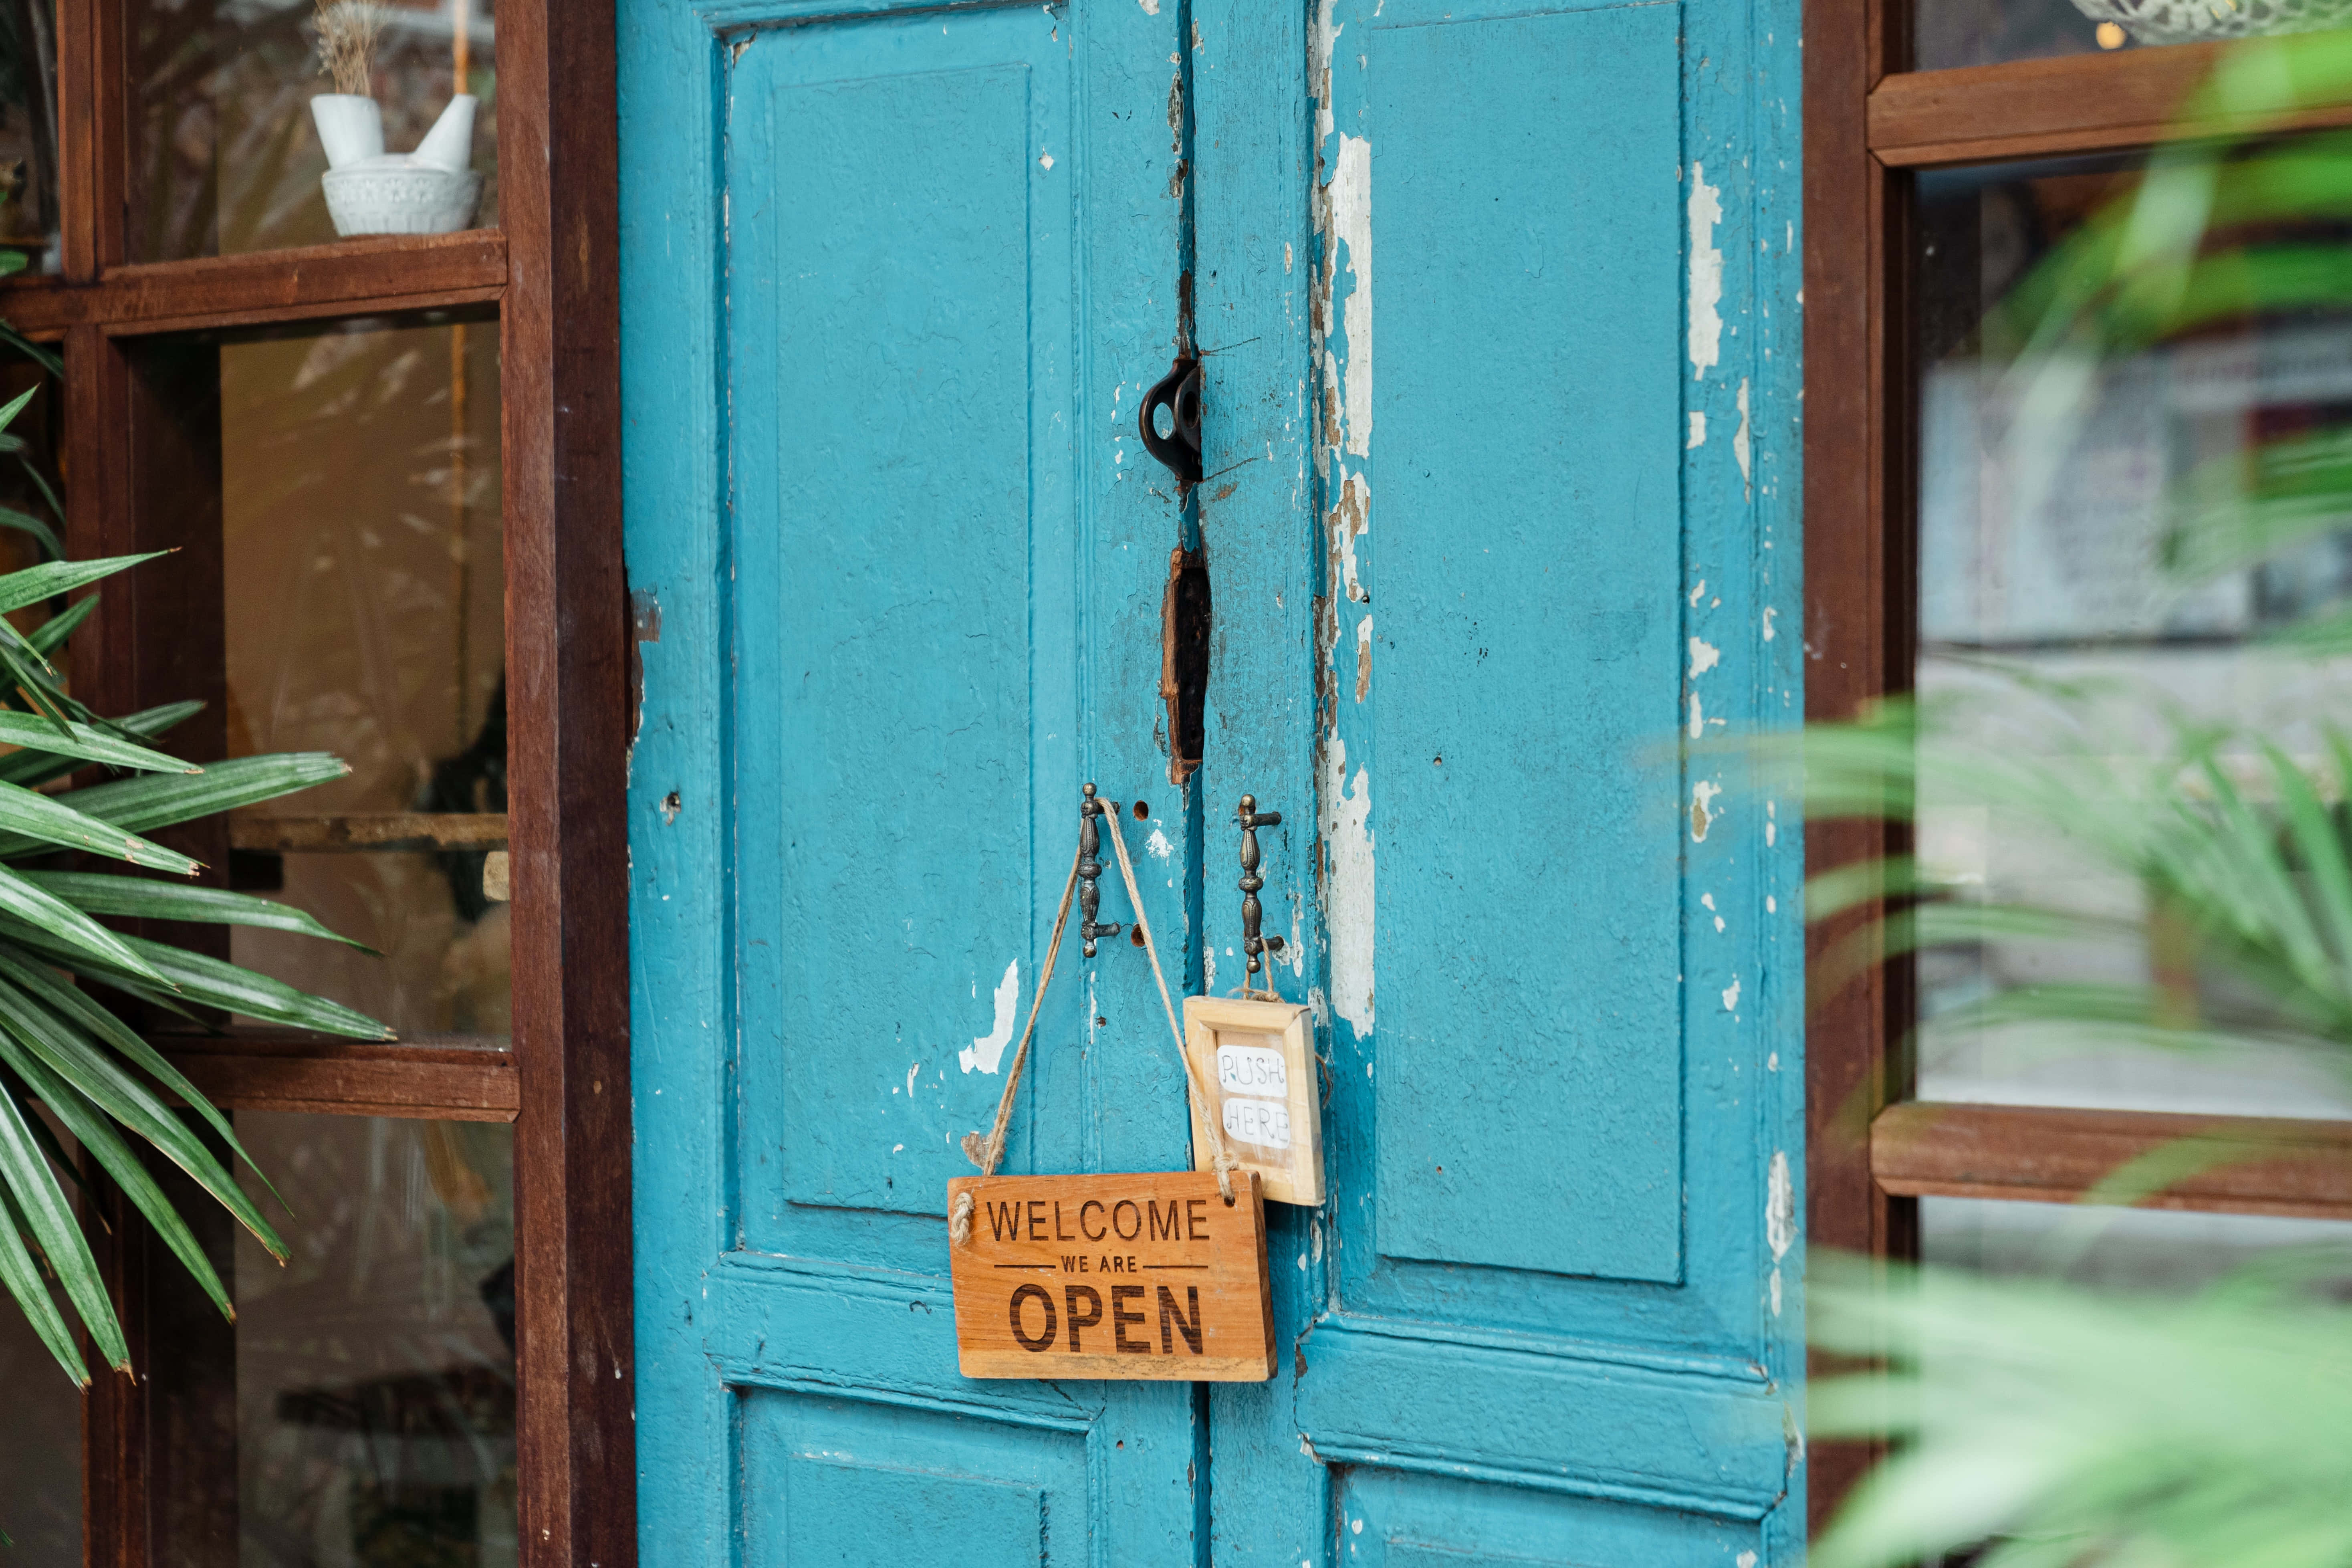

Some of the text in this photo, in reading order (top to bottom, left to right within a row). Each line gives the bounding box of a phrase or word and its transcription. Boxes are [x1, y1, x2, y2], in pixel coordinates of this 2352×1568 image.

[1222, 1055, 1285, 1085] PUSH
[1226, 1105, 1288, 1142] HERE
[986, 1200, 1210, 1241] WELCOME
[1061, 1255, 1137, 1273] WE ARE
[1009, 1283, 1203, 1354] OPEN
